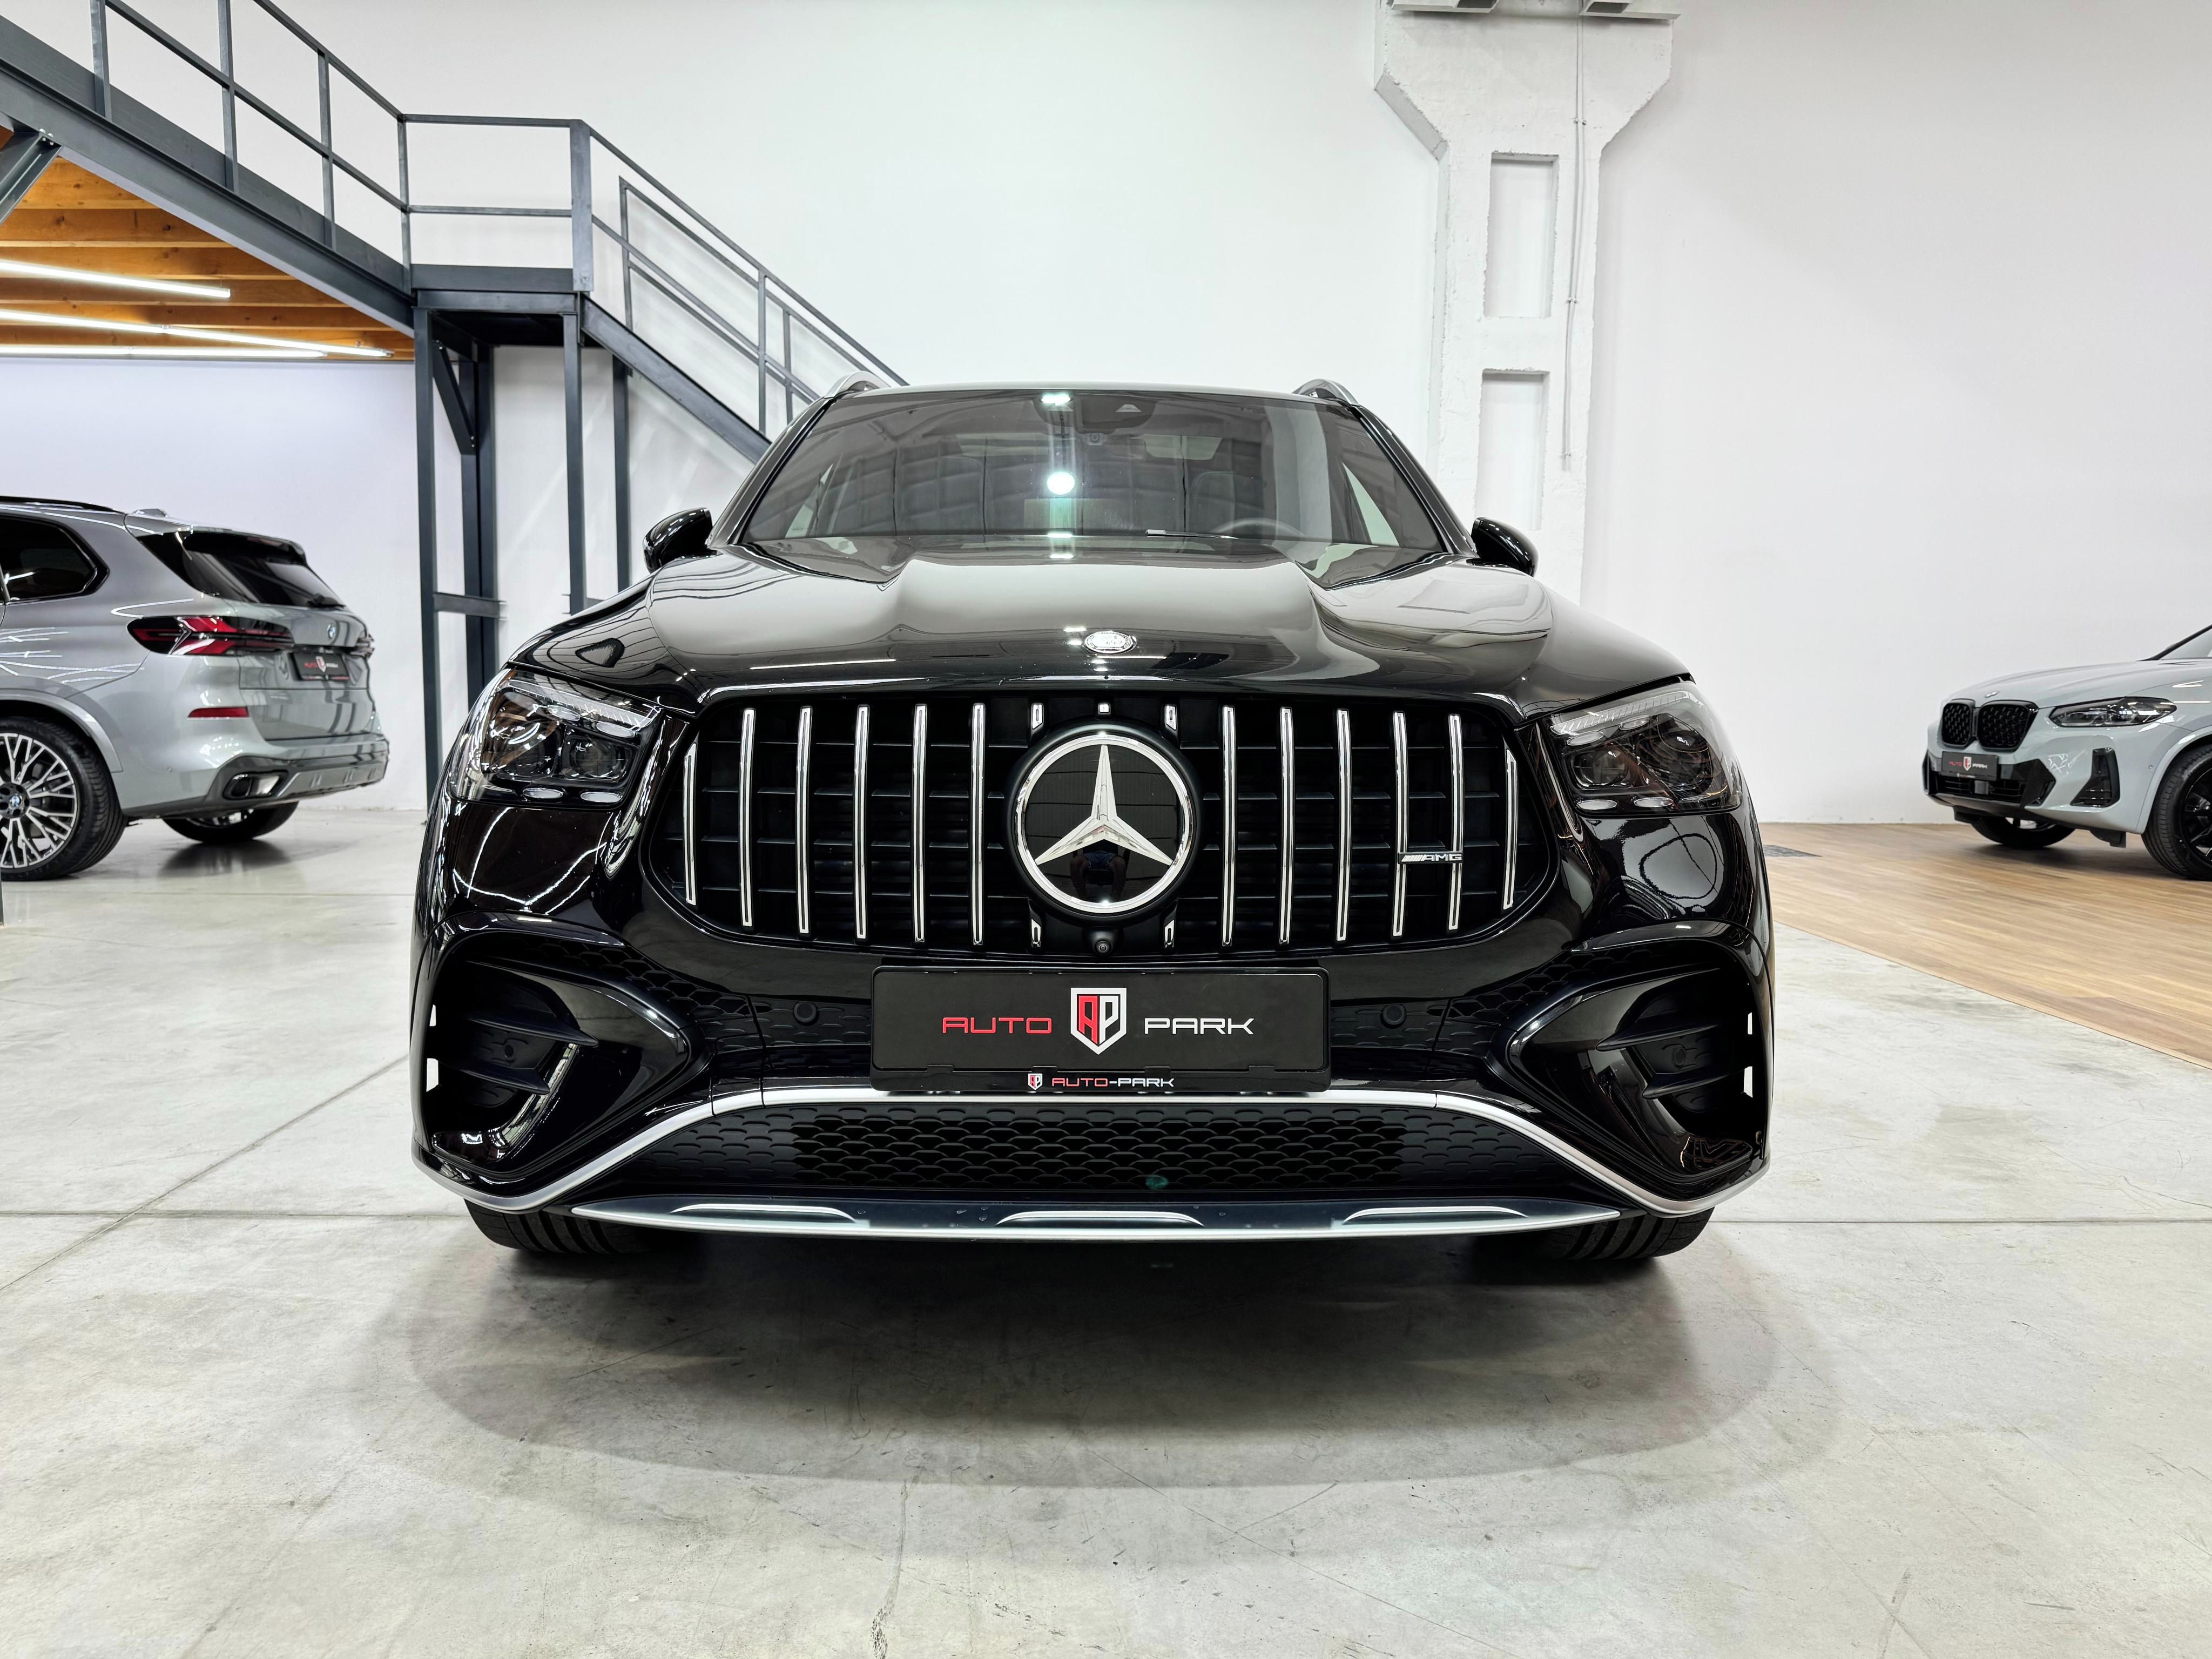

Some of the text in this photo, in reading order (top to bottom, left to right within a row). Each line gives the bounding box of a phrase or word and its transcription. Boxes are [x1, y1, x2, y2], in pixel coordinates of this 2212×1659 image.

[1420, 854, 1462, 862] AMG
[942, 1017, 1053, 1034] AUTO
[1144, 1017, 1255, 1035] PARK
[1052, 1078, 1175, 1087] AUTO-PARK
